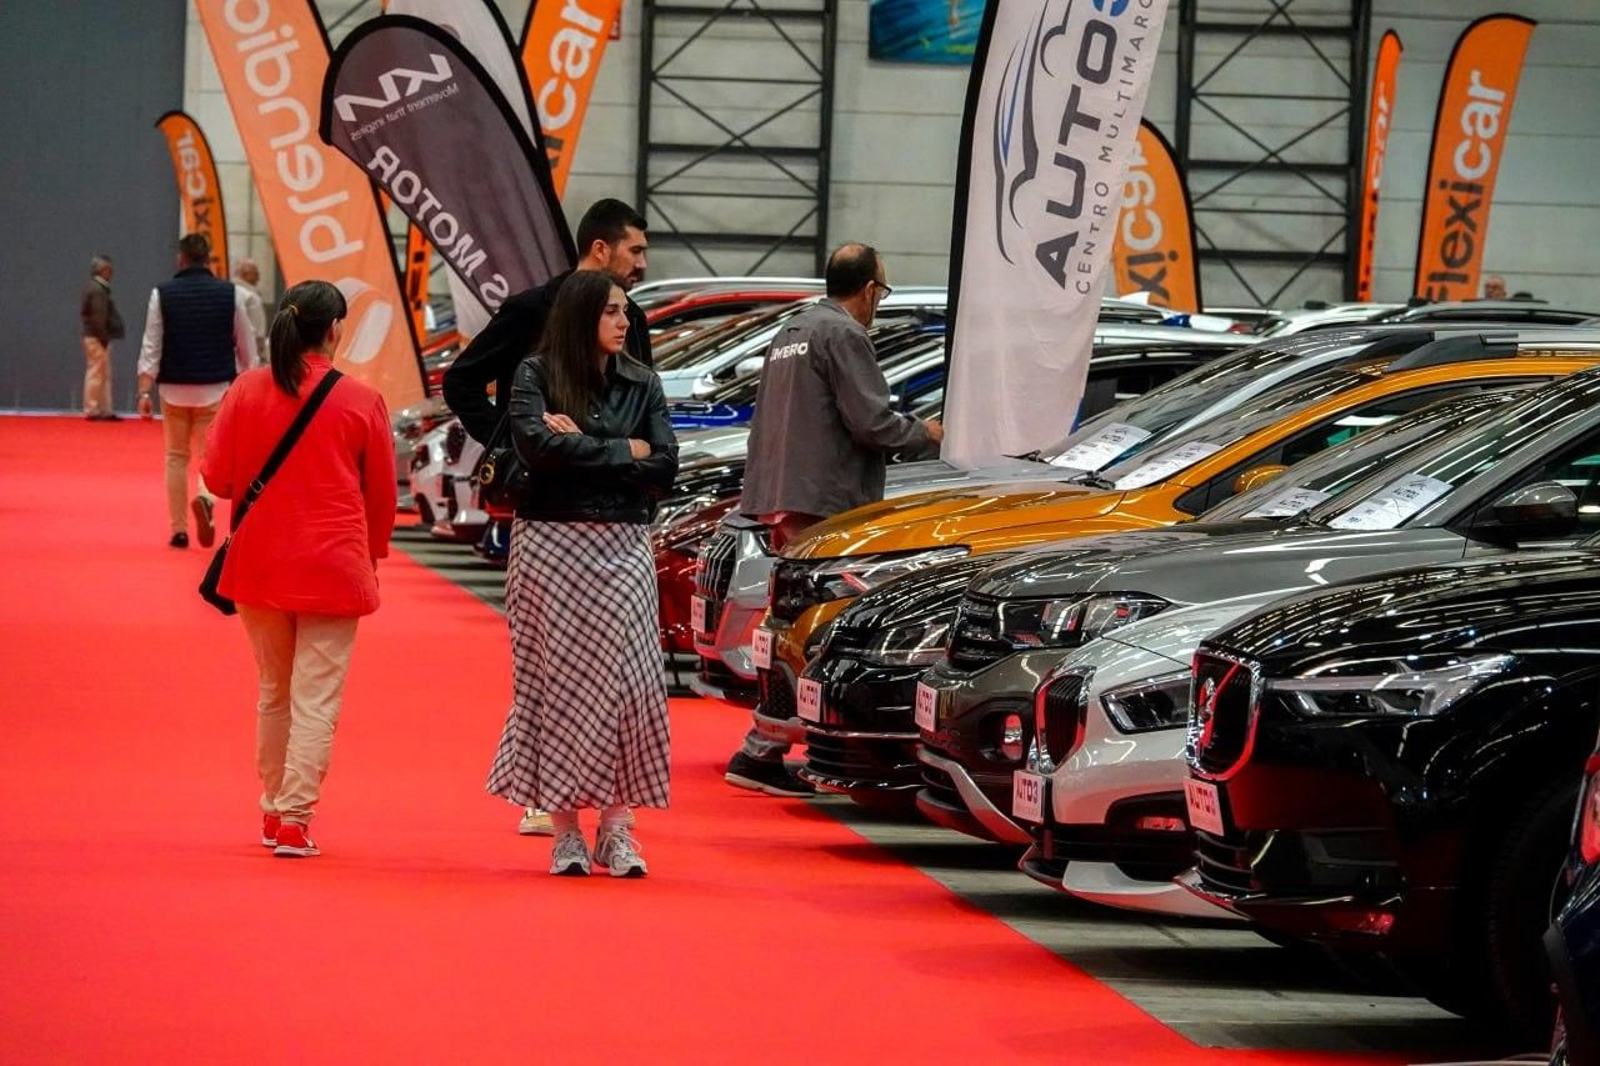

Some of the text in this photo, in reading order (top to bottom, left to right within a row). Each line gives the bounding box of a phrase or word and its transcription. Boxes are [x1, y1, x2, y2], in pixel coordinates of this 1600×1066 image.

[538, 0, 604, 169] car
[1035, 0, 1129, 290] AUTO
[1075, 181, 1109, 294] CENTRO
